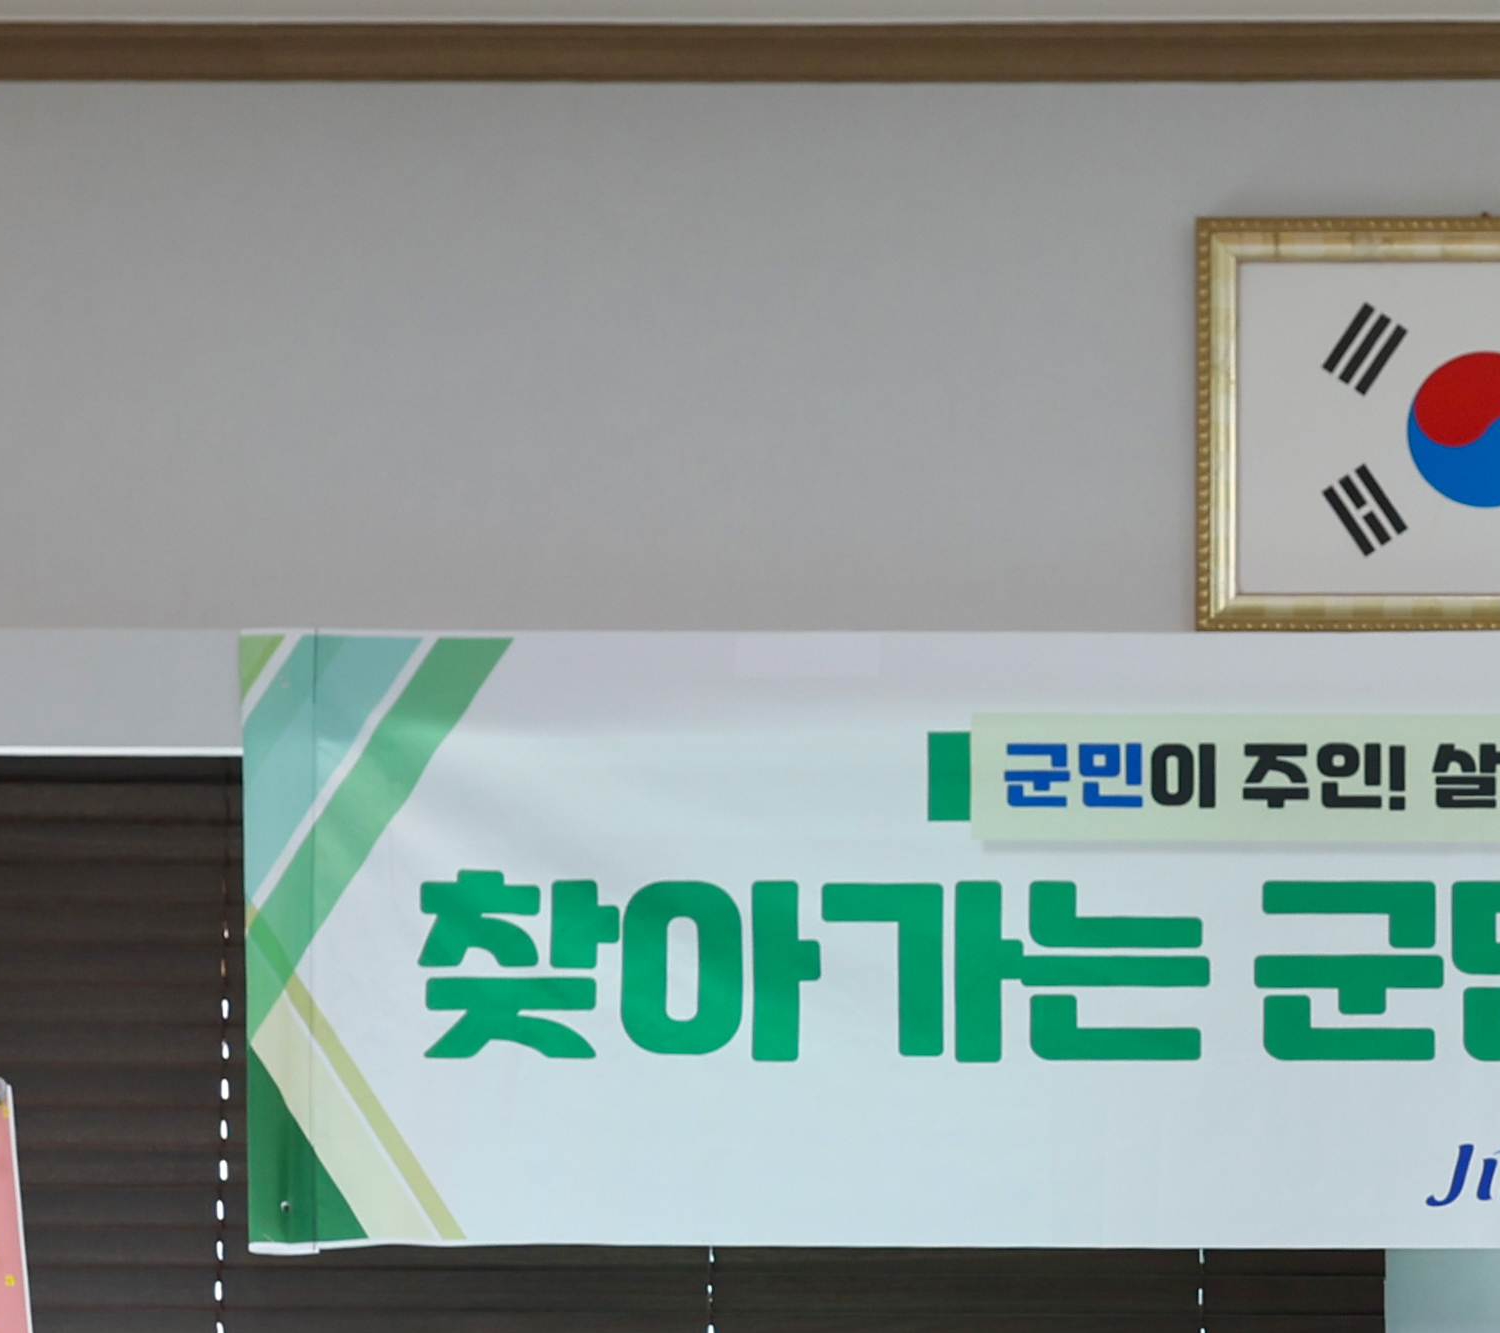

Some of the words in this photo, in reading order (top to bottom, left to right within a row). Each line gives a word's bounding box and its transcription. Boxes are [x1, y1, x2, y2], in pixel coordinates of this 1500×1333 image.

[1004, 743, 1218, 810] 군민이
[1242, 742, 1407, 812] 주인!
[420, 869, 1212, 1064] 찾아가는
